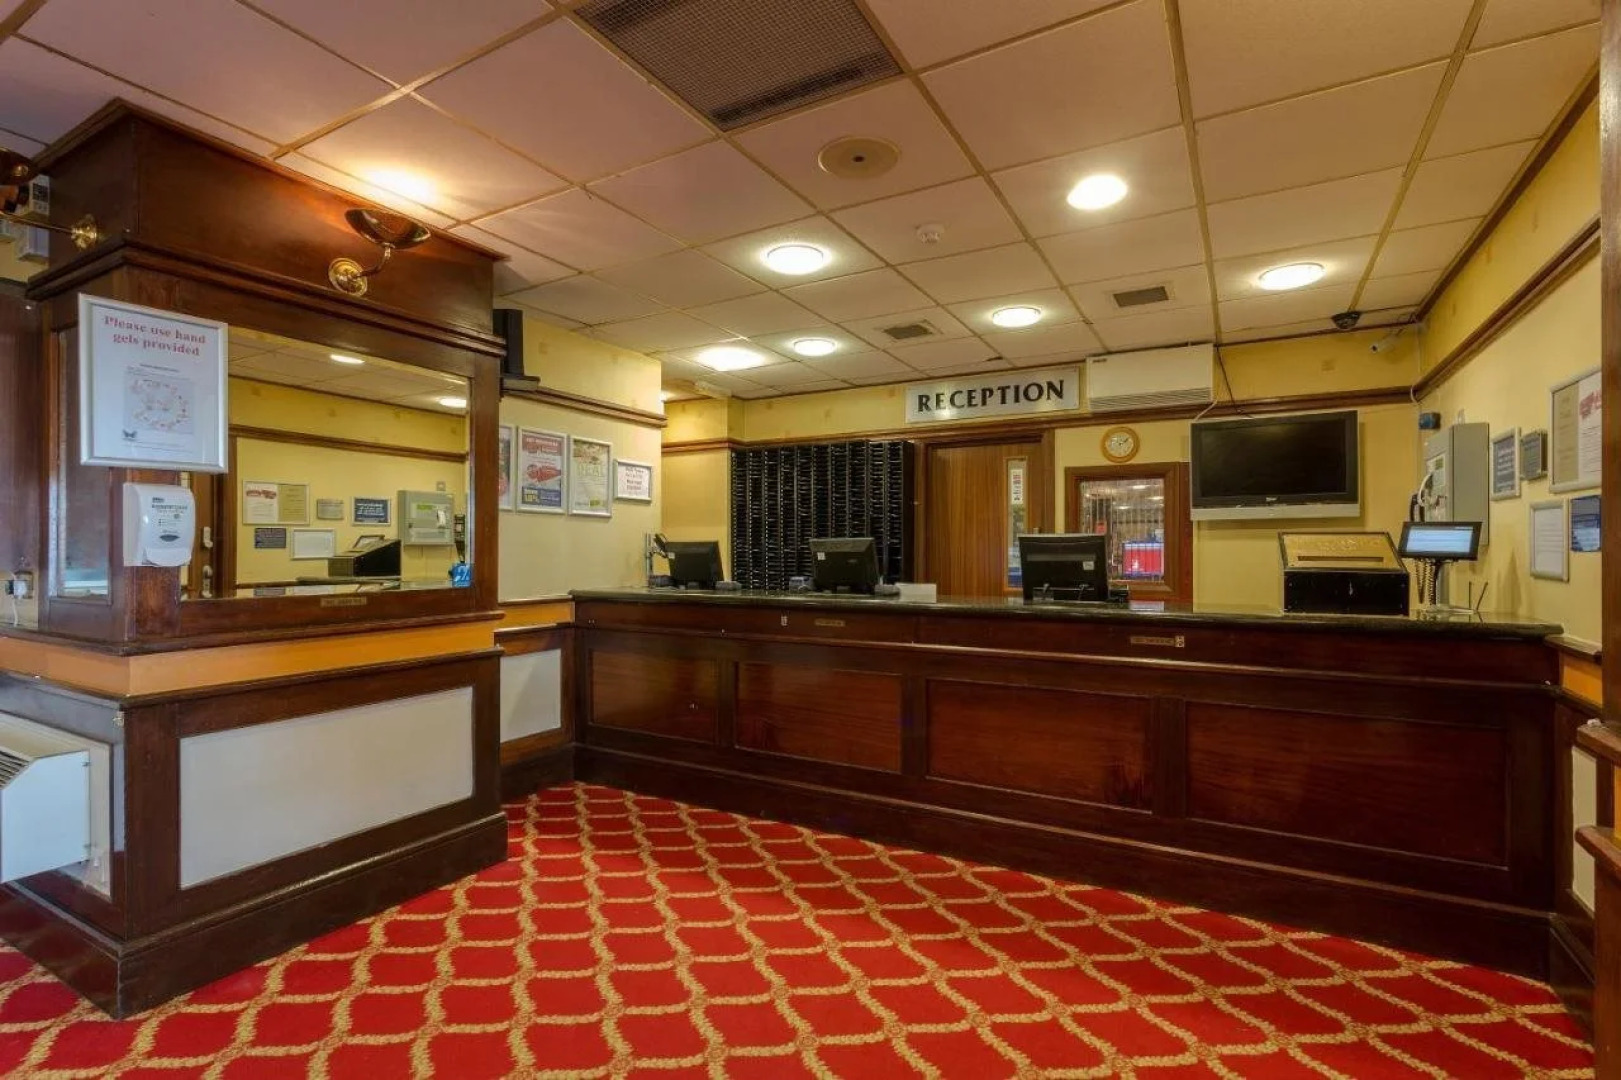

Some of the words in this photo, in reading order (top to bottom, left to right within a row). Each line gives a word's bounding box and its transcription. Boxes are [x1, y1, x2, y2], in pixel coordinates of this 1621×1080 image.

[104, 315, 147, 333] Please
[151, 327, 172, 336] use
[175, 328, 206, 343] hand
[112, 333, 139, 345] gels
[142, 339, 200, 356] provided
[917, 379, 1064, 412] RECEPTION
